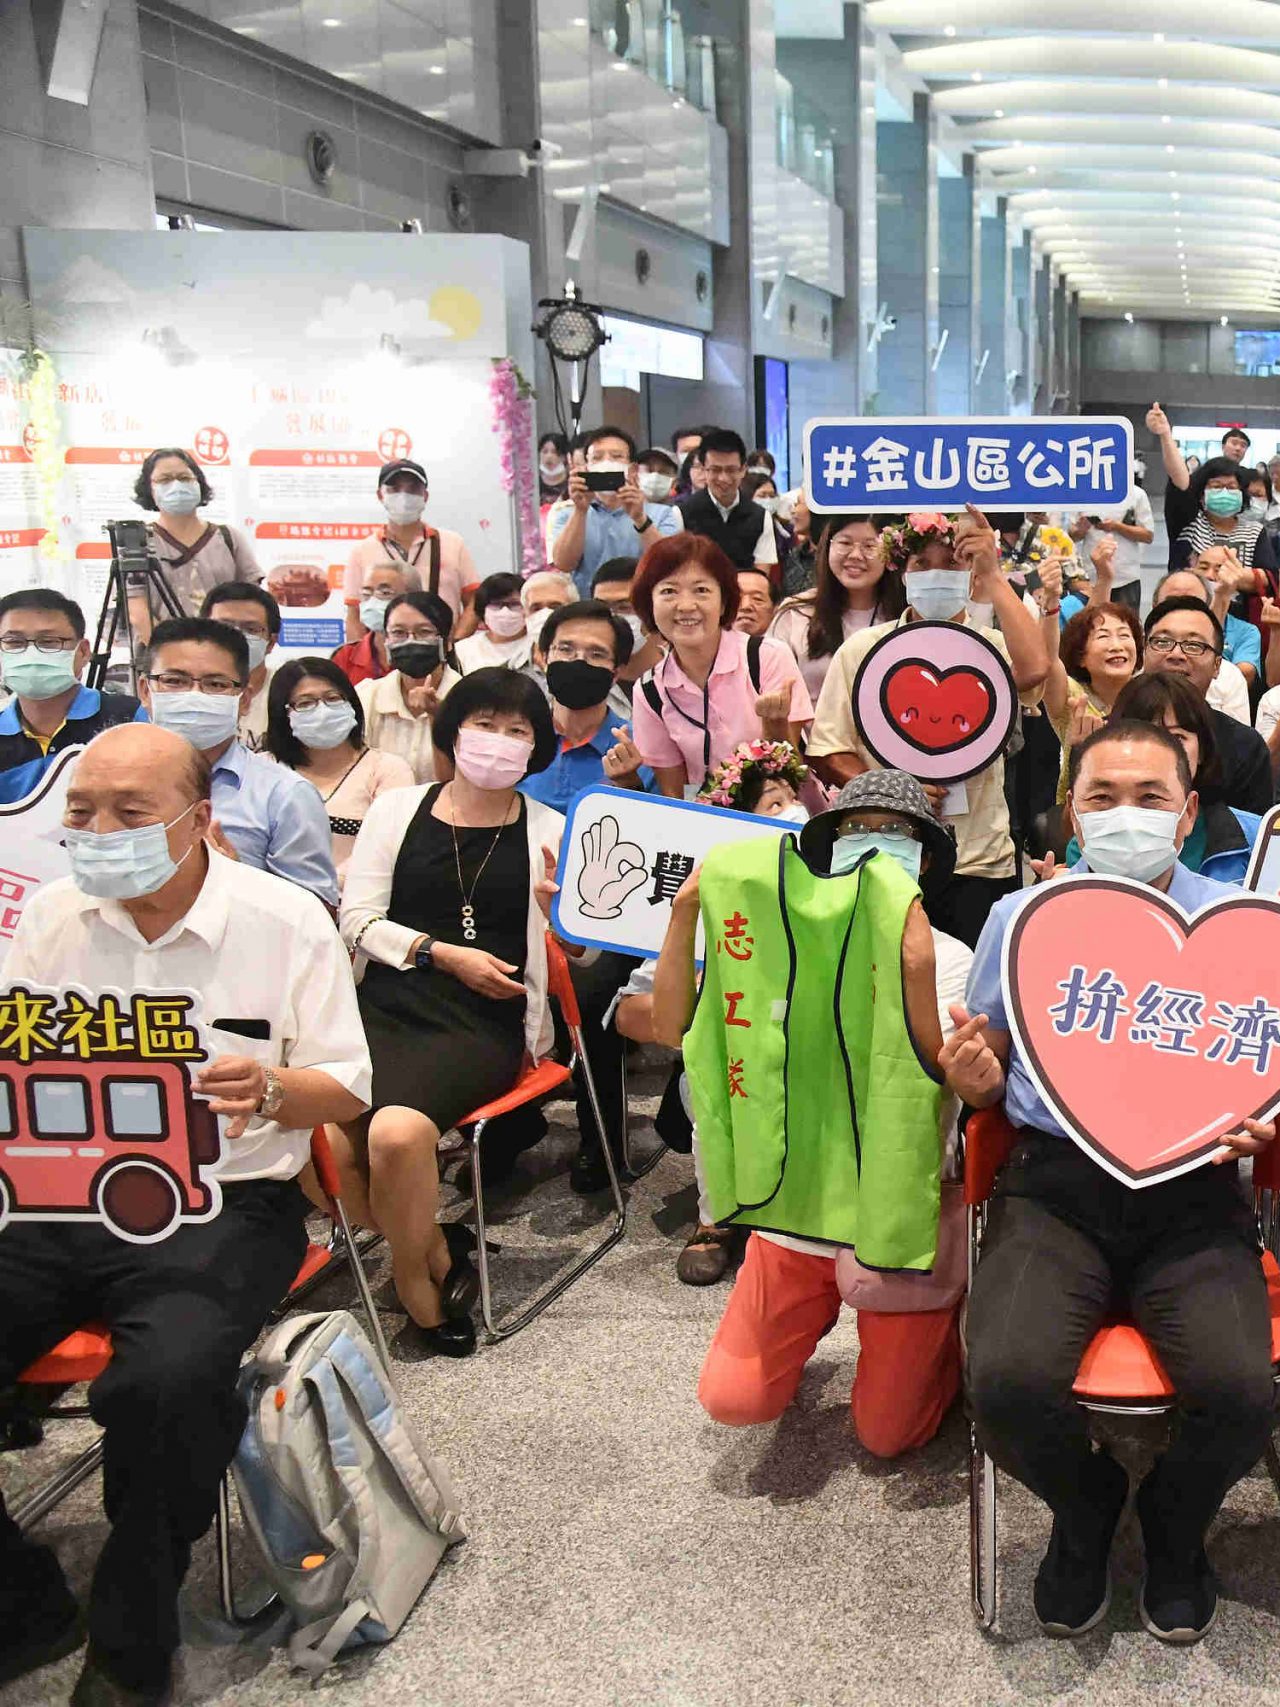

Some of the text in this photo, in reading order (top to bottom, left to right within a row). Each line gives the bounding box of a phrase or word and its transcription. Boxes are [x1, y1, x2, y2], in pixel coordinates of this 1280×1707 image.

[822, 436, 1116, 492] #金山區公所
